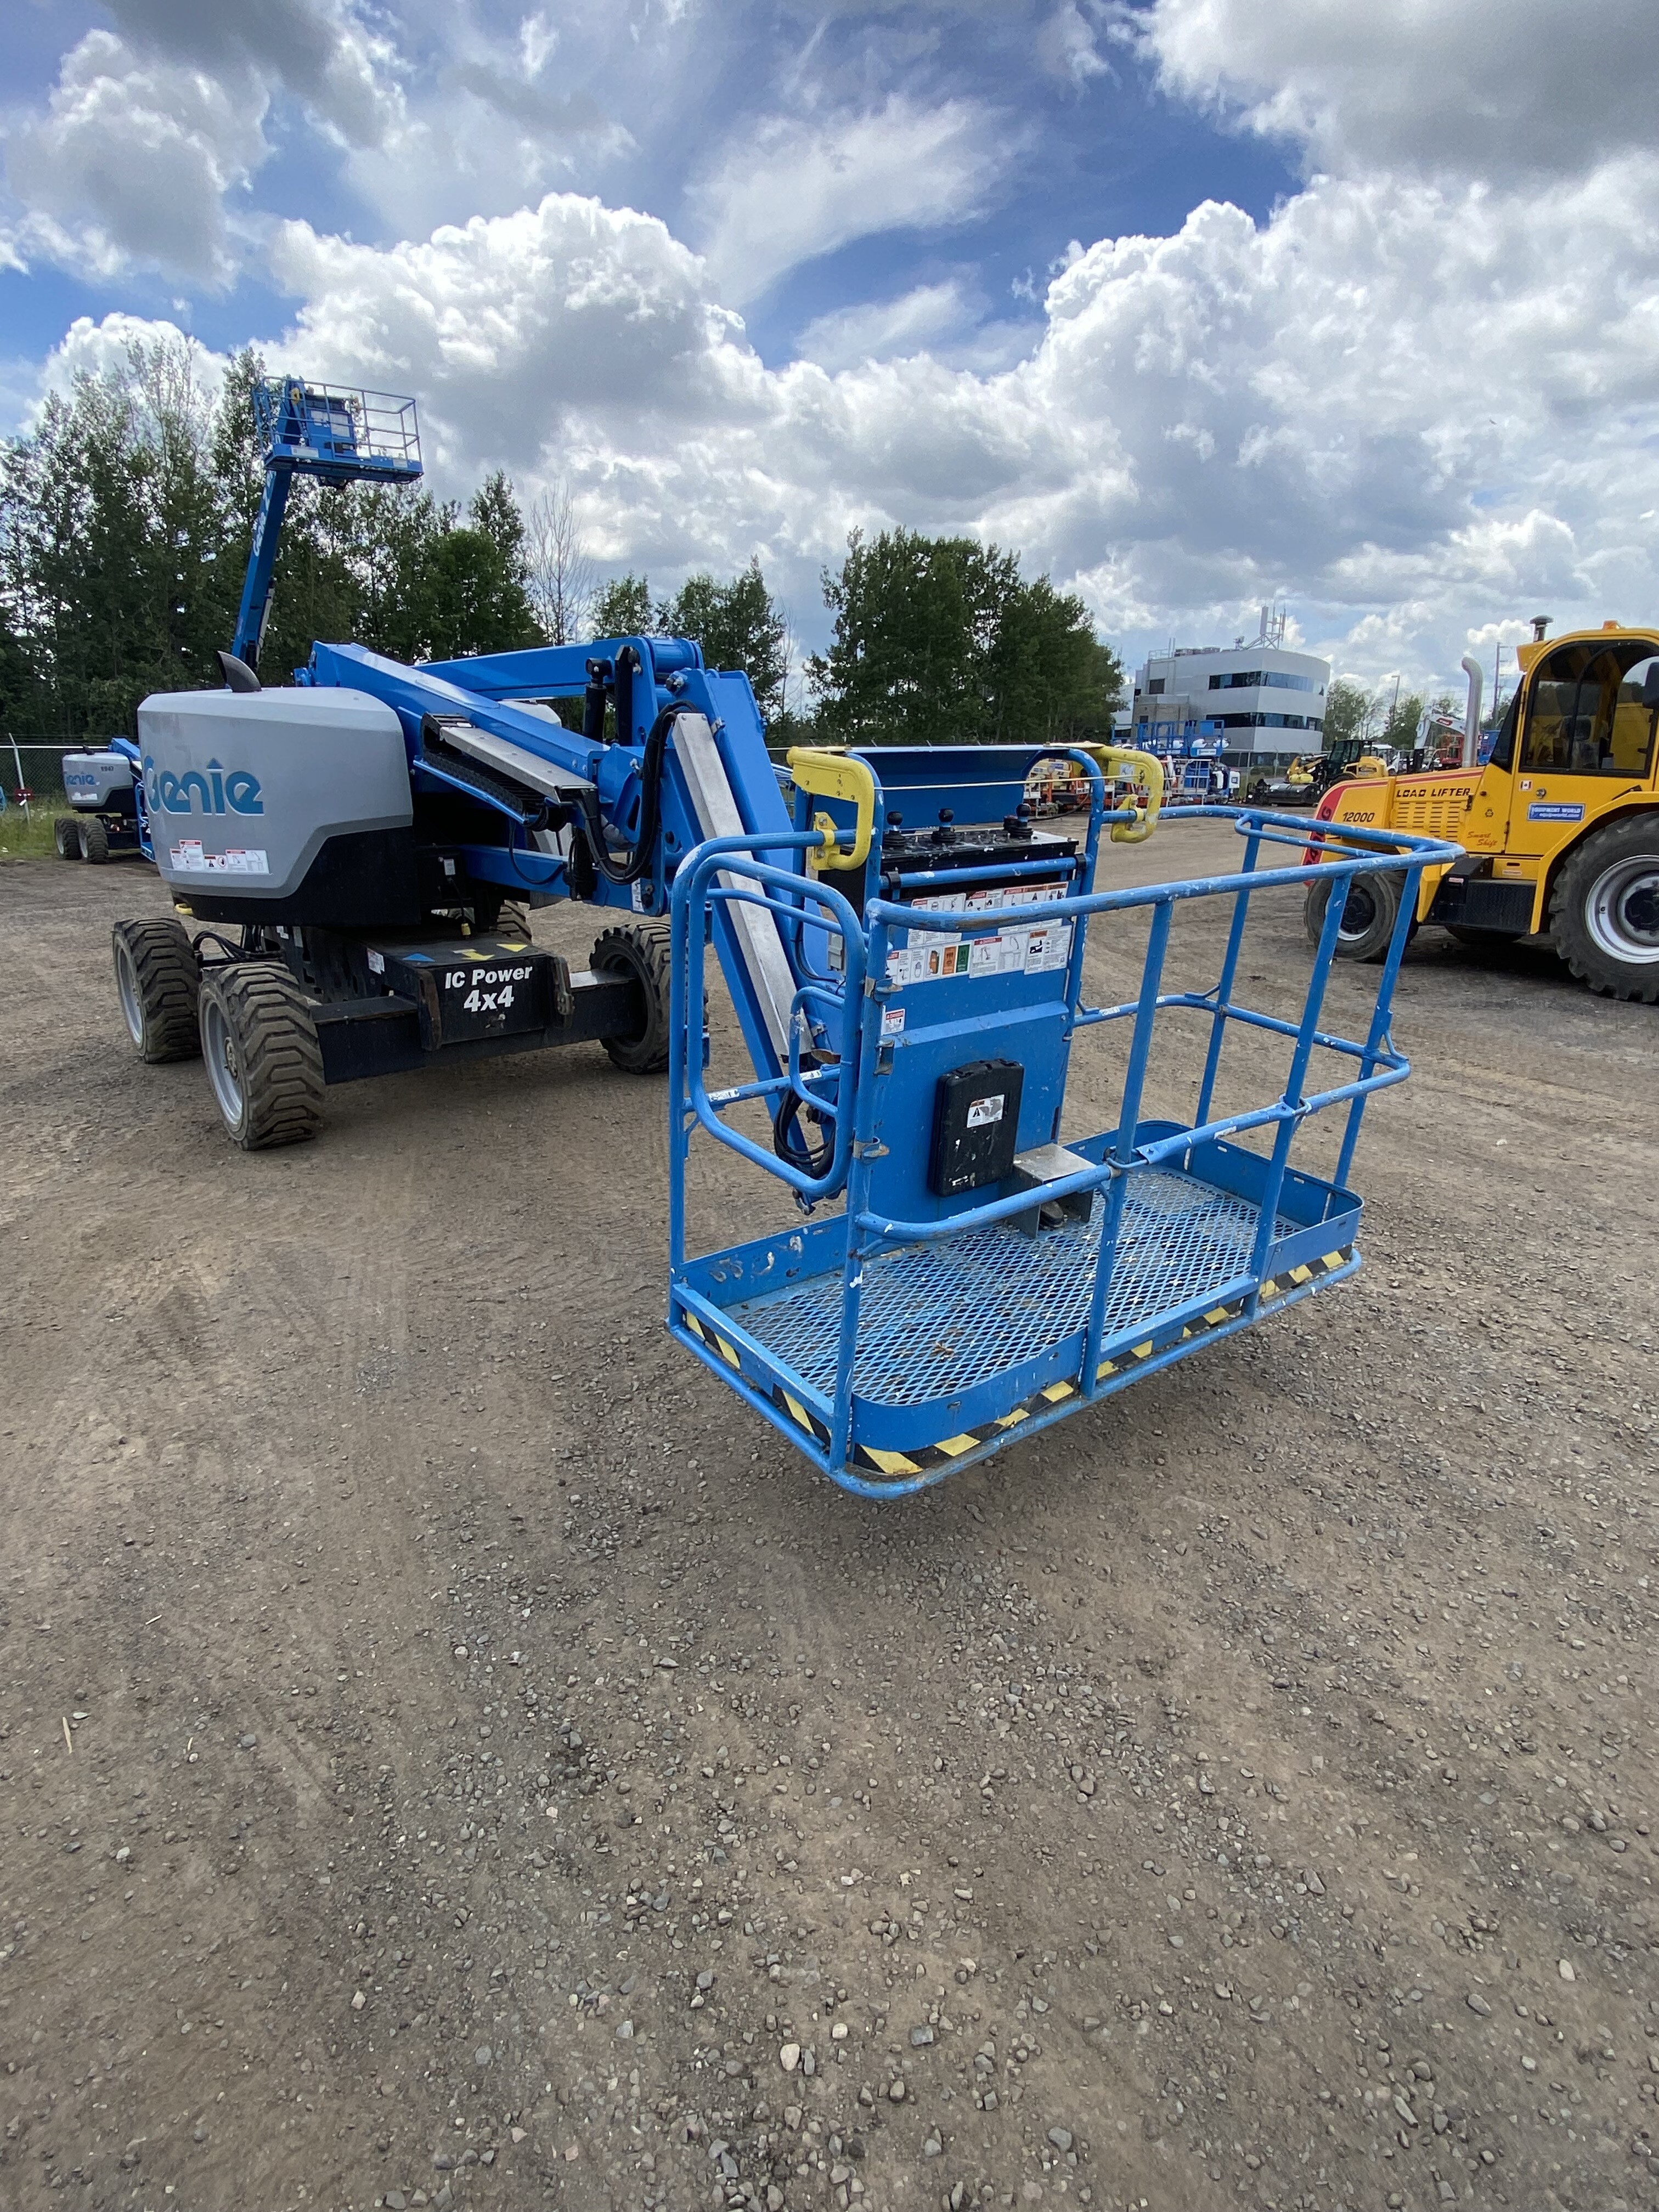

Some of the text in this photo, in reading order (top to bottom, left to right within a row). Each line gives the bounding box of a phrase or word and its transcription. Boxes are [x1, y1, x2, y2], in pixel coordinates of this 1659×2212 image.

[1431, 788, 1470, 797] LIFTER
[1343, 812, 1375, 822] 12000
[445, 966, 533, 989] IC Power
[464, 985, 514, 1012] 4x4
